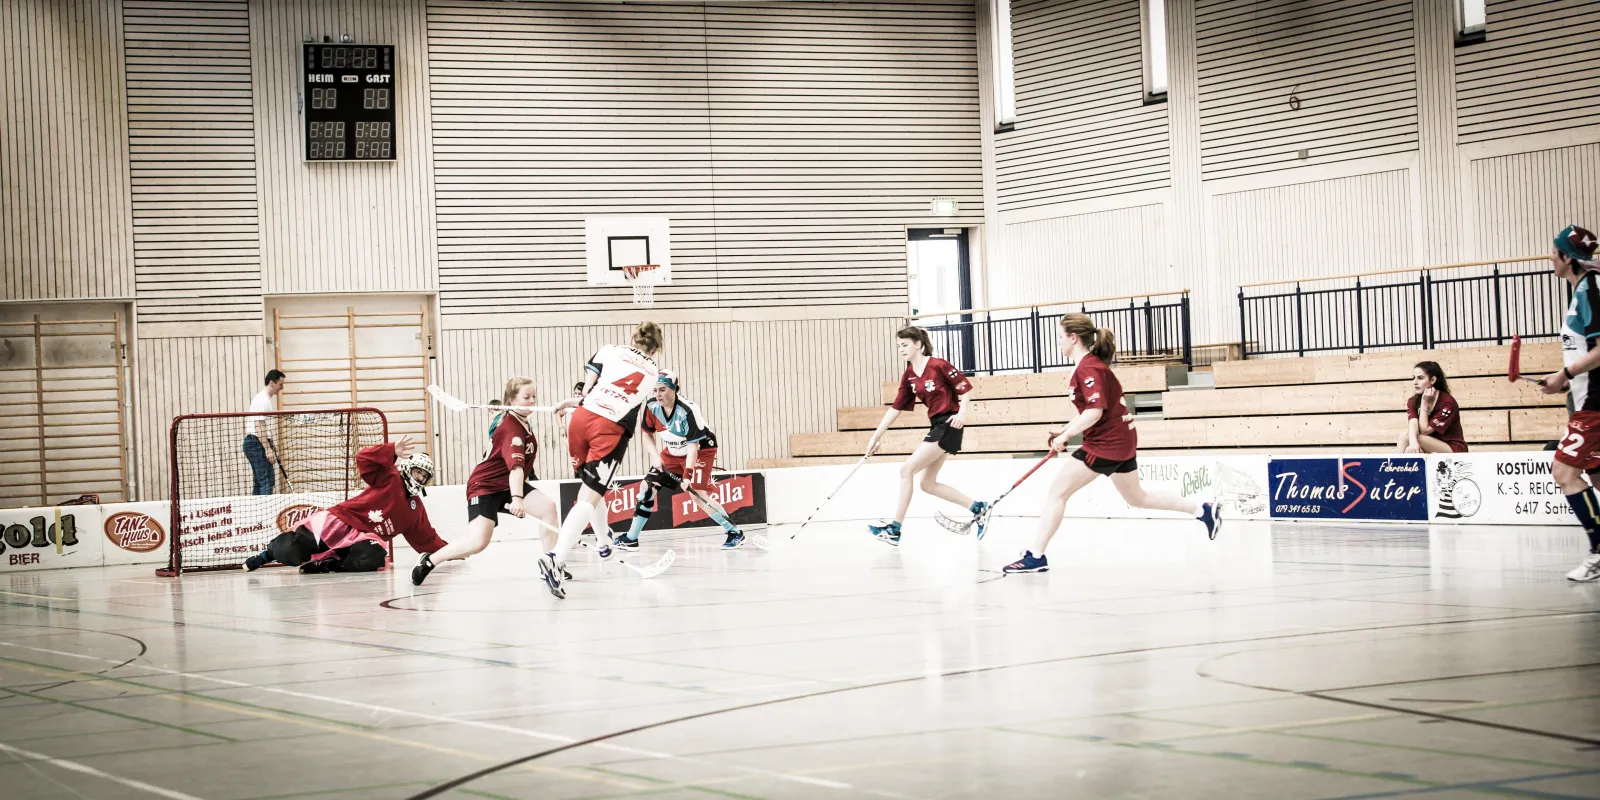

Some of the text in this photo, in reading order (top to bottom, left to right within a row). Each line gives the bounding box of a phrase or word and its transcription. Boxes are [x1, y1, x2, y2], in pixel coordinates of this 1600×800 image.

[308, 74, 334, 83] HEIM
[366, 74, 391, 83] GAST
[611, 371, 645, 395] 4
[525, 442, 534, 454] 20
[1138, 464, 1179, 481] STHAUS
[1379, 461, 1419, 473] Fahrschule
[1497, 459, 1554, 475] KOSTÜMV
[1274, 472, 1349, 500] Thomas
[1529, 481, 1562, 495] REICH
[196, 503, 232, 518] Usgang
[1275, 504, 1321, 514] 079 341 65 83
[1515, 501, 1576, 514] 6417 Satte
[115, 515, 149, 534] TANZ
[192, 521, 217, 532] wenn
[220, 517, 232, 527] du
[0, 514, 79, 555] old
[121, 529, 150, 547] HUUS
[180, 536, 205, 549] etsch
[9, 553, 40, 565] BIER
